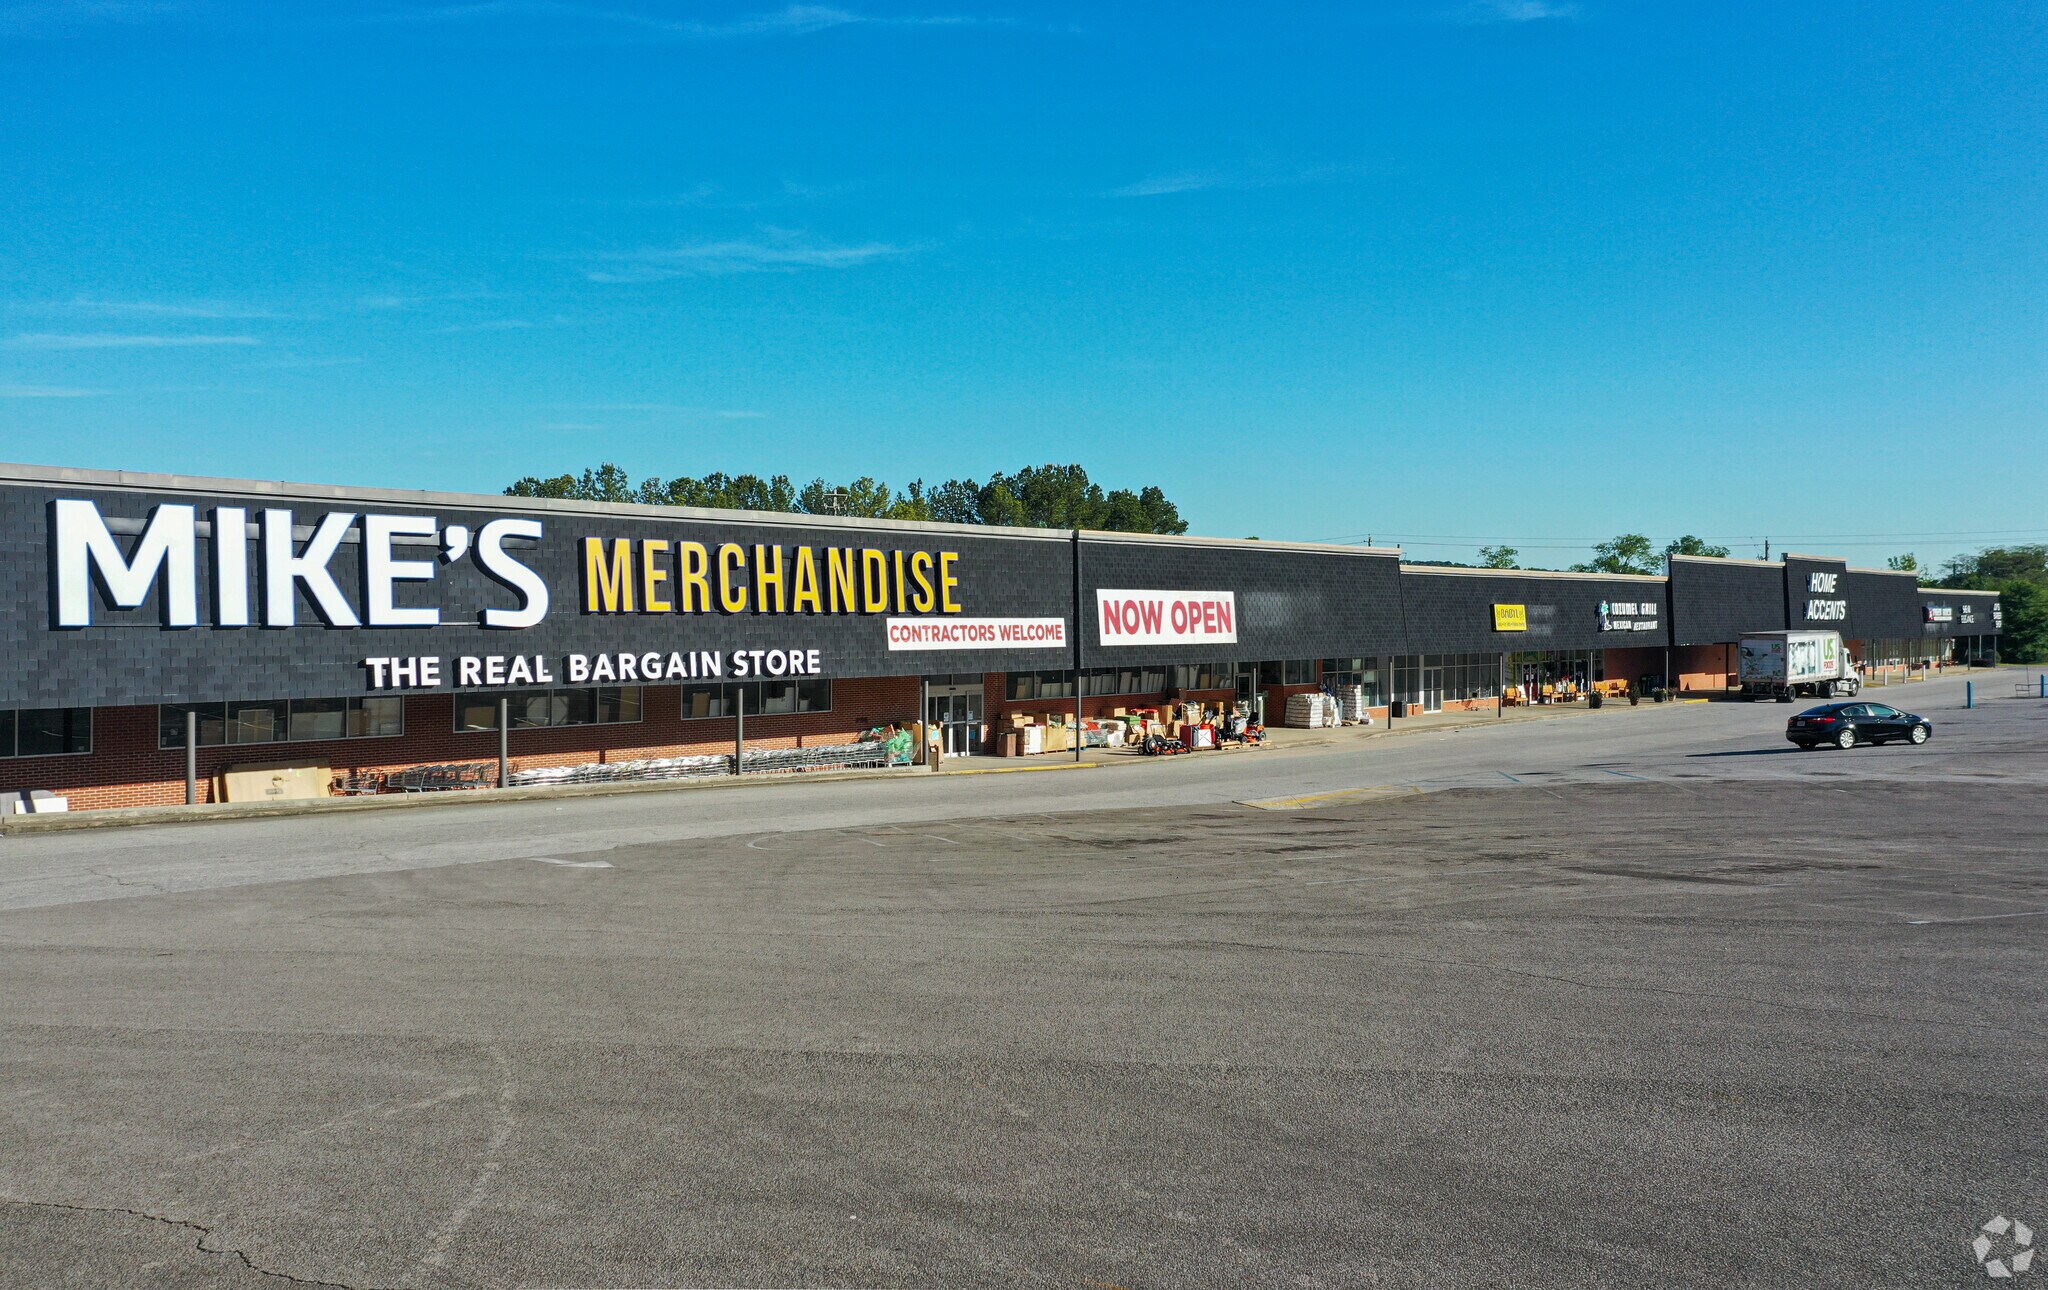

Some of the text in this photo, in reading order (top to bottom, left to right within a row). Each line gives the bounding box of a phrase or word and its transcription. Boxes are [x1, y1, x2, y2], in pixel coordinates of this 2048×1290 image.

[54, 498, 549, 628] MIKE'S
[585, 537, 963, 614] MERCHANDISE
[1810, 572, 1838, 593] HOME
[1102, 600, 1234, 636] NOW OPEN
[1807, 599, 1846, 620] ACCENTS
[889, 624, 1063, 643] CONTRACTORS WELCOME
[365, 649, 821, 688] THE REAL BARGAIN STORE
